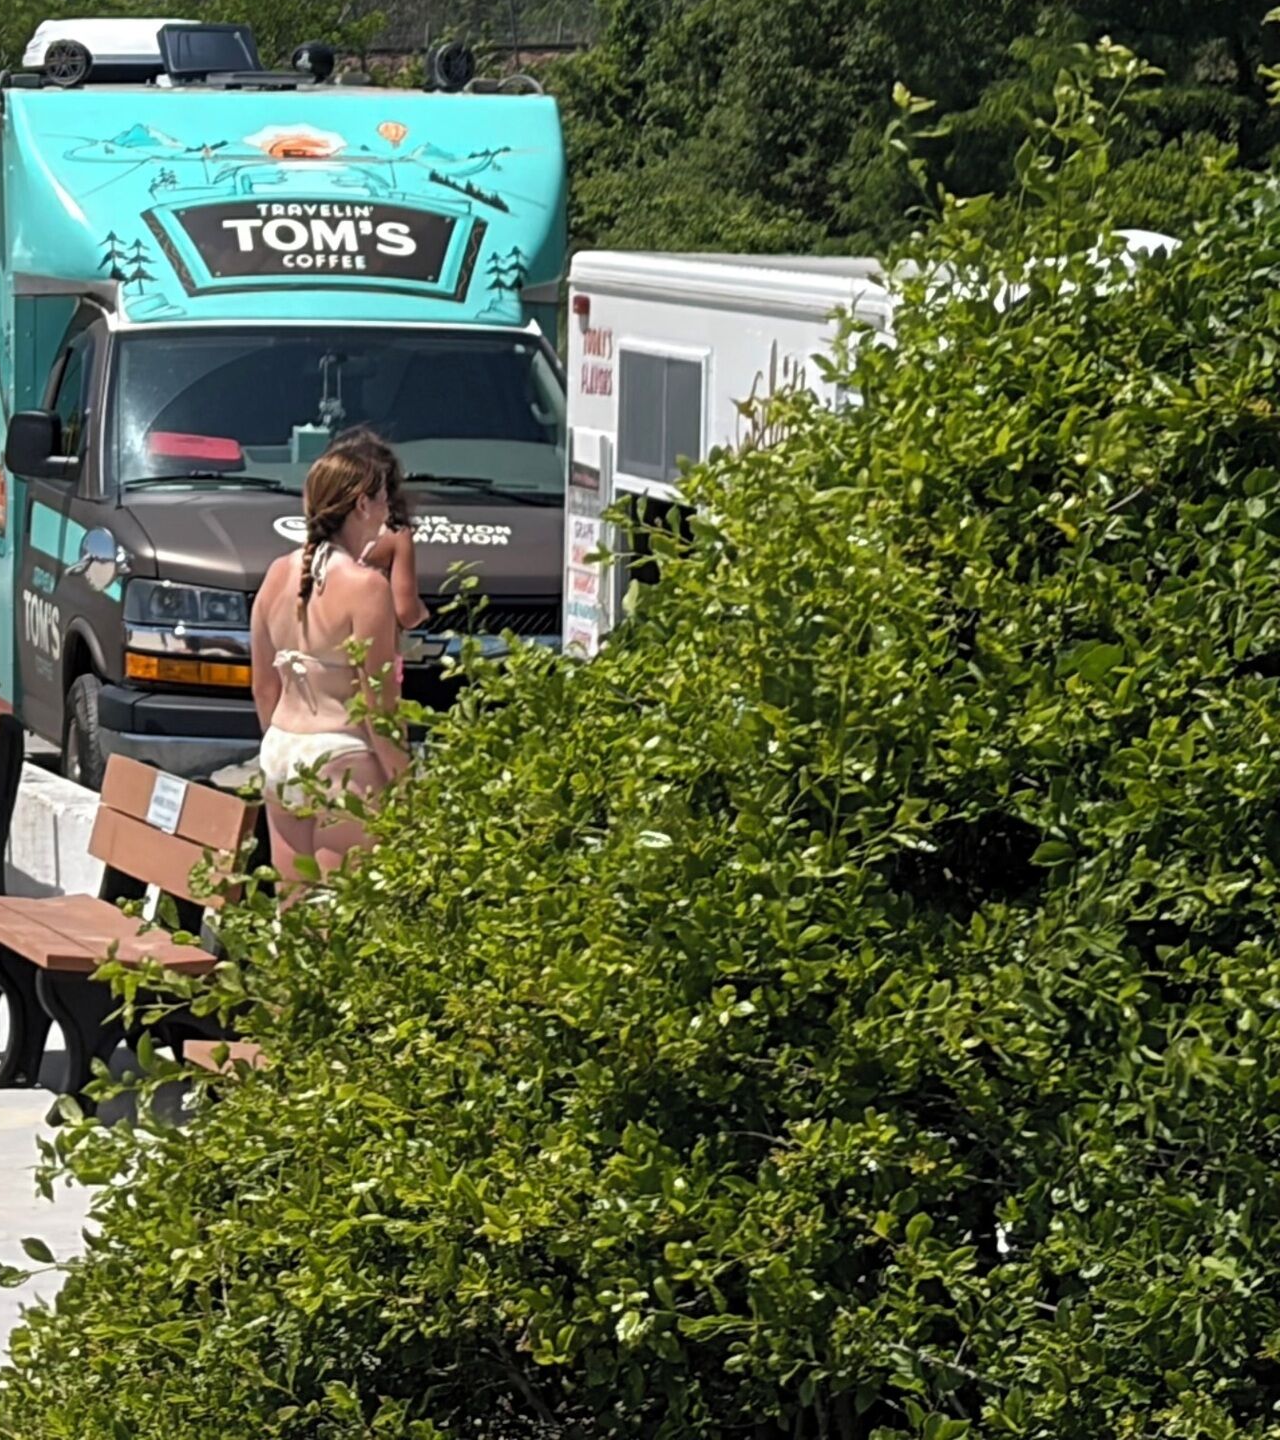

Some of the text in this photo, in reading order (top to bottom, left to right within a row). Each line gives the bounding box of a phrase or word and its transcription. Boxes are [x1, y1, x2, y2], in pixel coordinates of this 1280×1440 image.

[256, 203, 374, 218] TRAVELIN'
[222, 218, 418, 257] TOM'S
[282, 253, 367, 270] COFFEE
[412, 532, 509, 545] NATION
[23, 589, 60, 660] TOM'S
